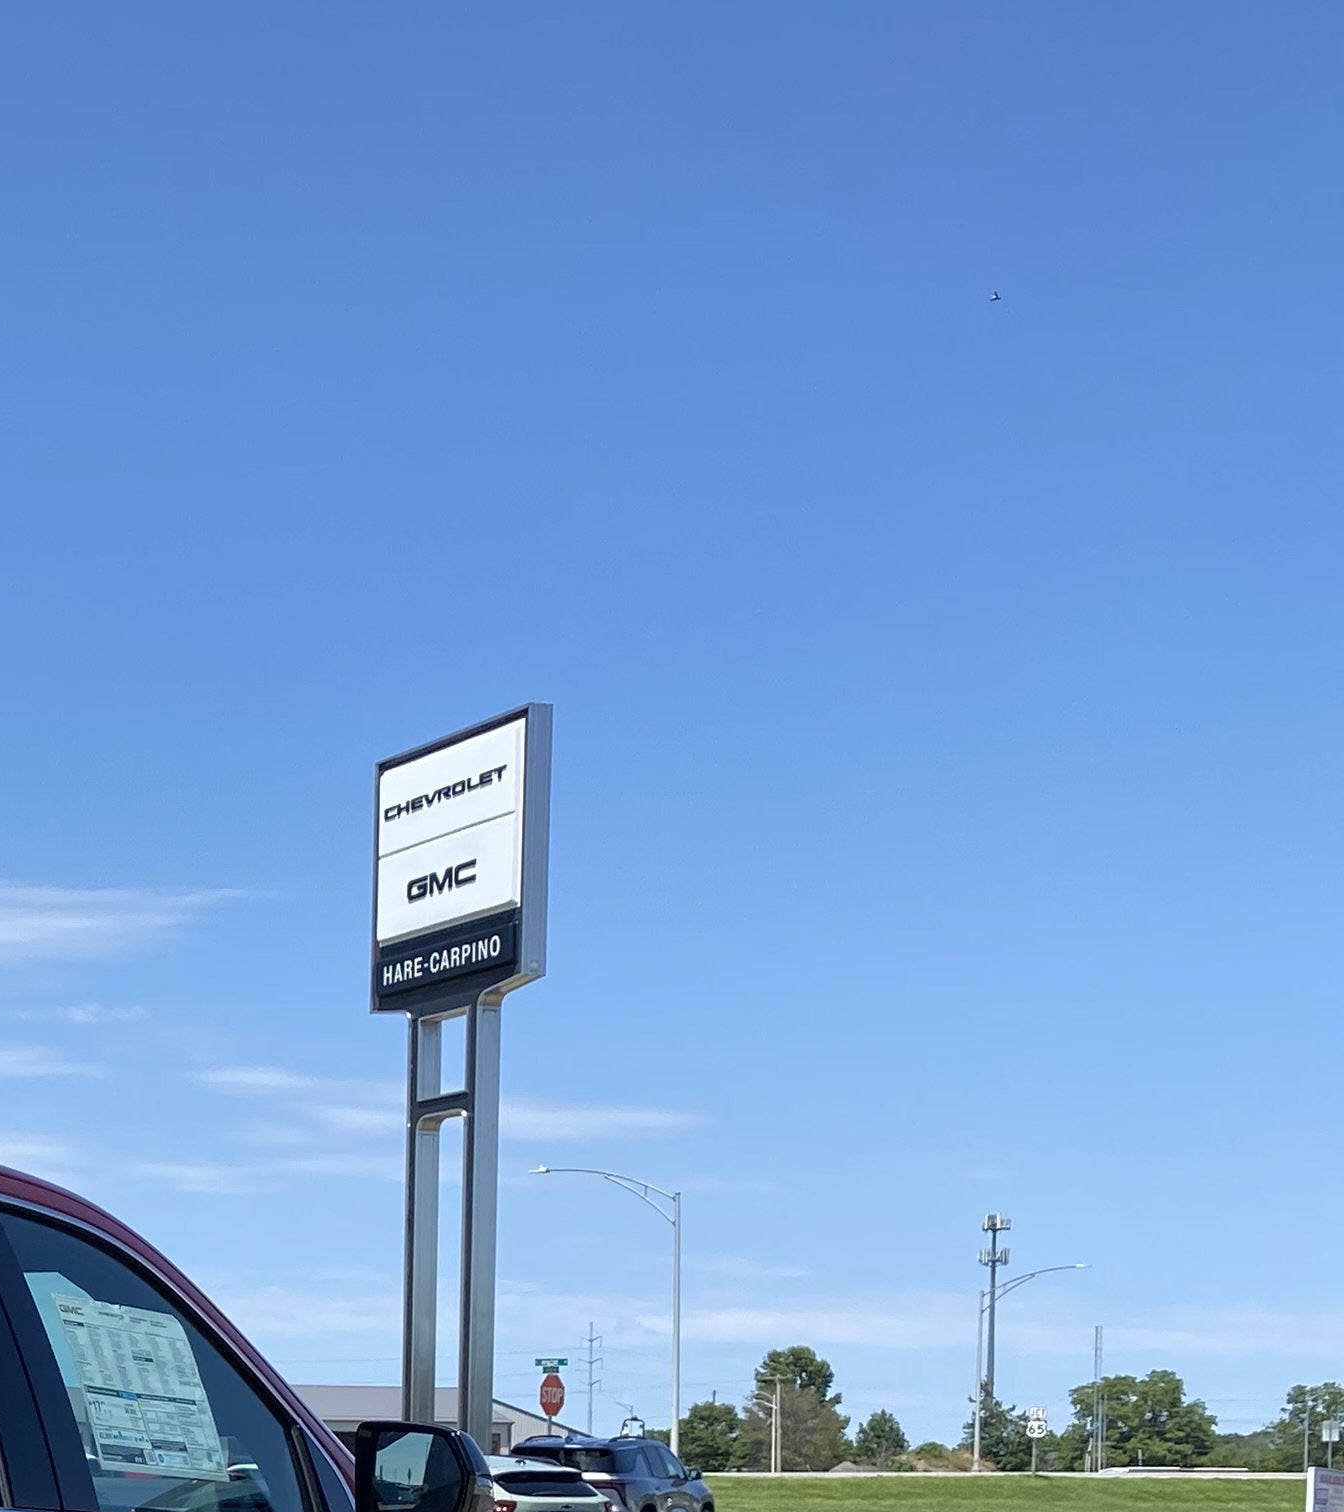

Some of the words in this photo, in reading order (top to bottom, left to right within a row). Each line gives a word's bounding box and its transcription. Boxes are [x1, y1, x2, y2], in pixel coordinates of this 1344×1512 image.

[384, 764, 507, 822] CHEVROLET
[406, 858, 477, 903] GMC
[383, 935, 501, 986] HARE-CARPINO
[541, 1387, 563, 1403] STOP
[1028, 1424, 1044, 1435] 65
